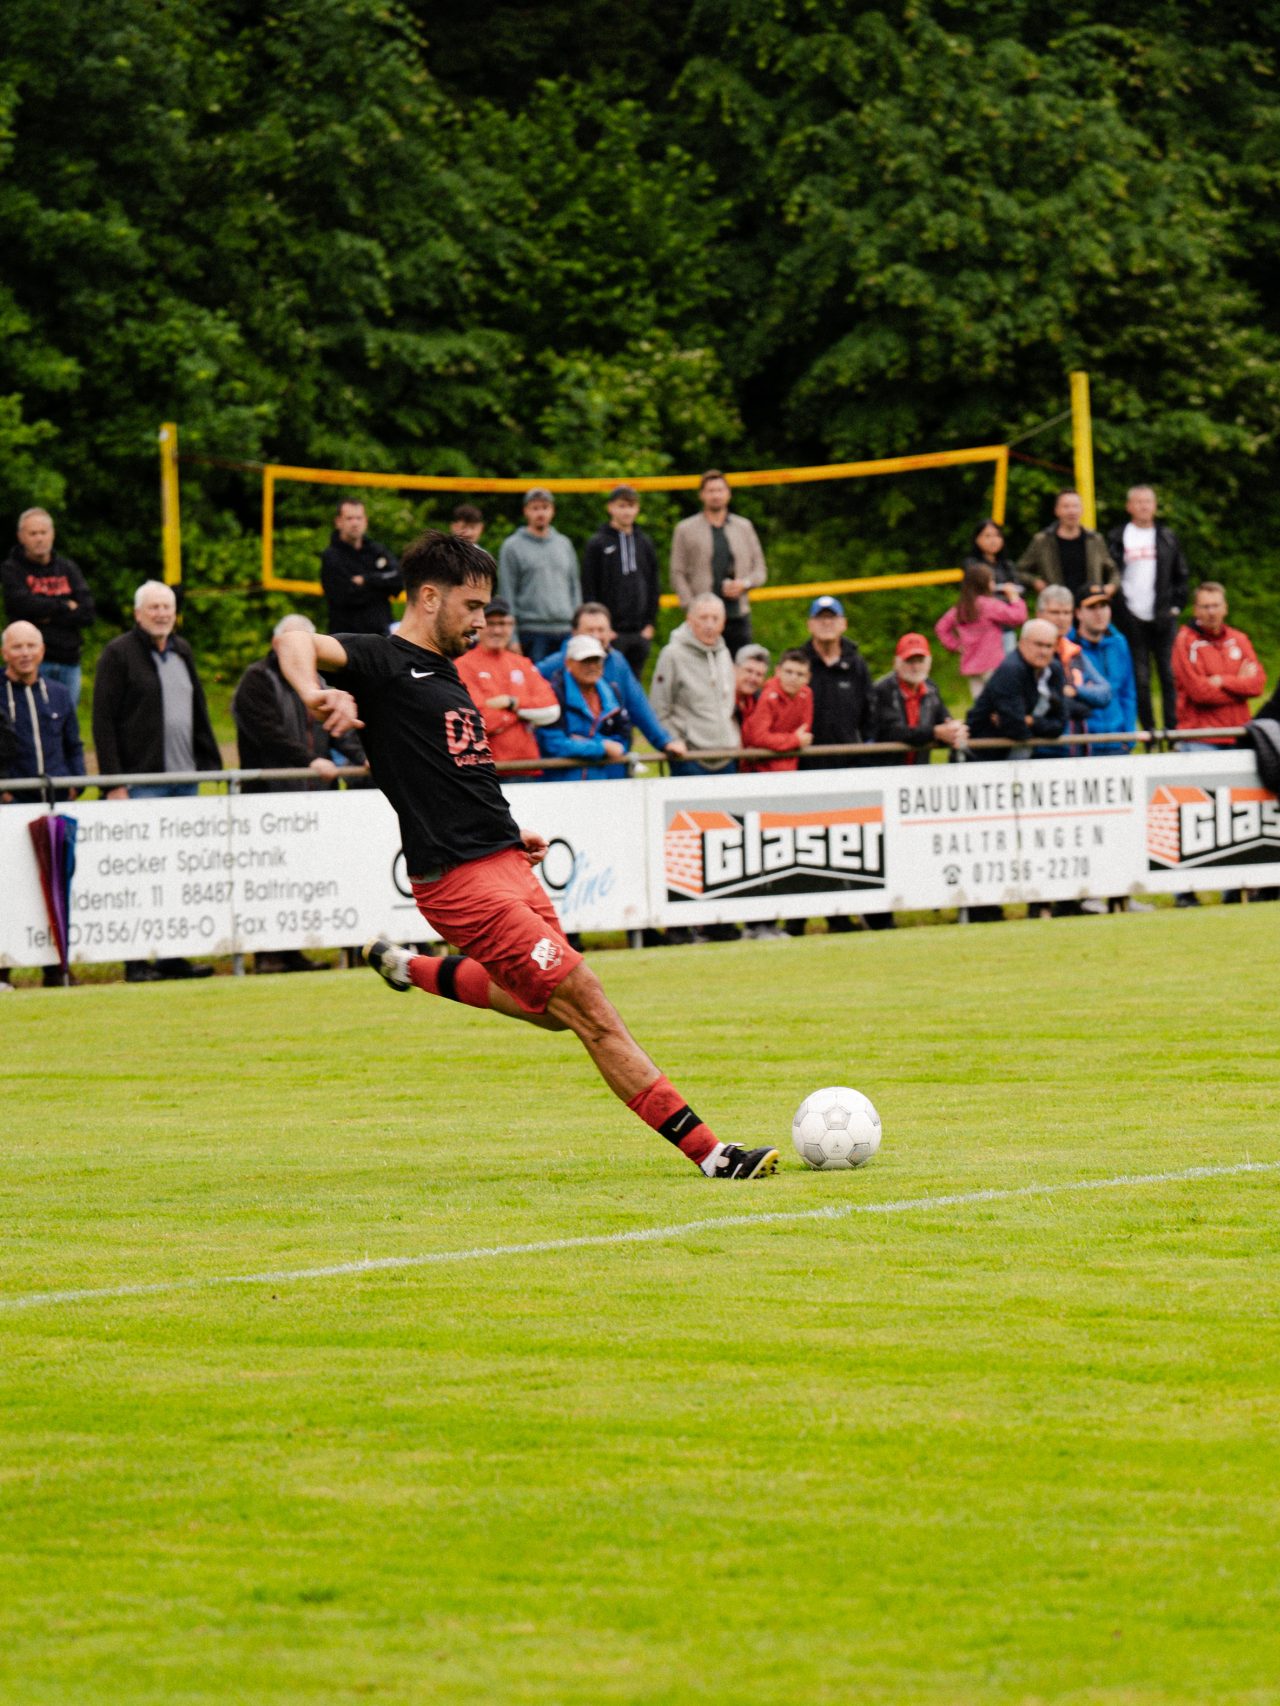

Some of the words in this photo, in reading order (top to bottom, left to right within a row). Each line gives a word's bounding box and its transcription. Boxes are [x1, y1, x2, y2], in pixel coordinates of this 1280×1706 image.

[899, 777, 1133, 815] BAUUNTERNEHMEN
[77, 820, 150, 843] arlheinz
[159, 815, 250, 839] Friedrichs
[260, 811, 319, 835] GmbH
[932, 824, 1105, 856] BALTRINGEN
[97, 853, 167, 876] decker
[176, 846, 287, 874] Spültechnik
[704, 811, 884, 886] Glaser
[972, 856, 1091, 884] 07356-2270
[151, 885, 163, 907] 11
[181, 881, 234, 905] 88487
[243, 877, 339, 904] Baltringen
[234, 913, 266, 936] Fax
[276, 906, 359, 933] 9358-50
